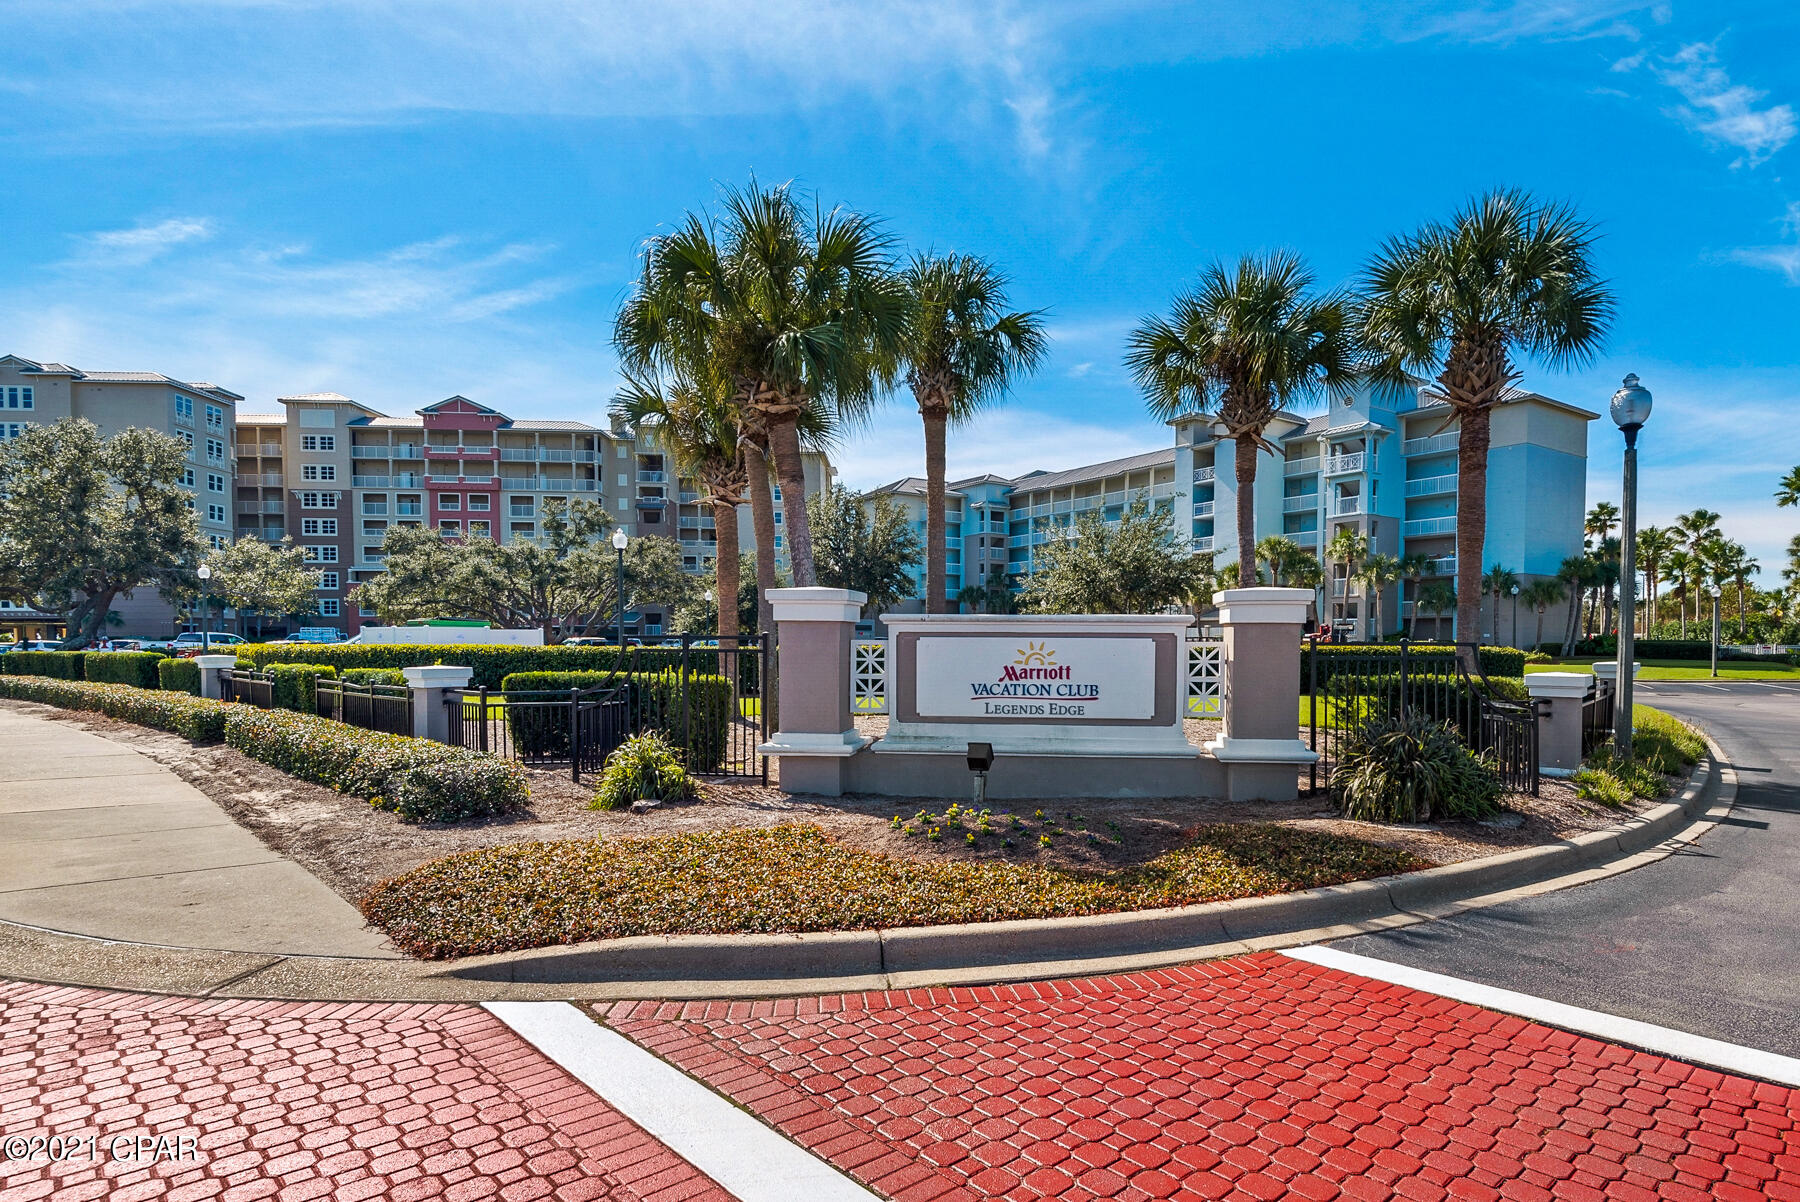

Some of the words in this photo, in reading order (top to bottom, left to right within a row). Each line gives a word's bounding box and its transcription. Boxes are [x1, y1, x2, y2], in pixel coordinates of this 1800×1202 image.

[998, 665, 1072, 682] Marriott
[971, 683, 1052, 697] VACATION
[1056, 683, 1099, 697] CLUB
[984, 702, 1045, 715] LEGENDS
[1049, 703, 1085, 716] EDGE
